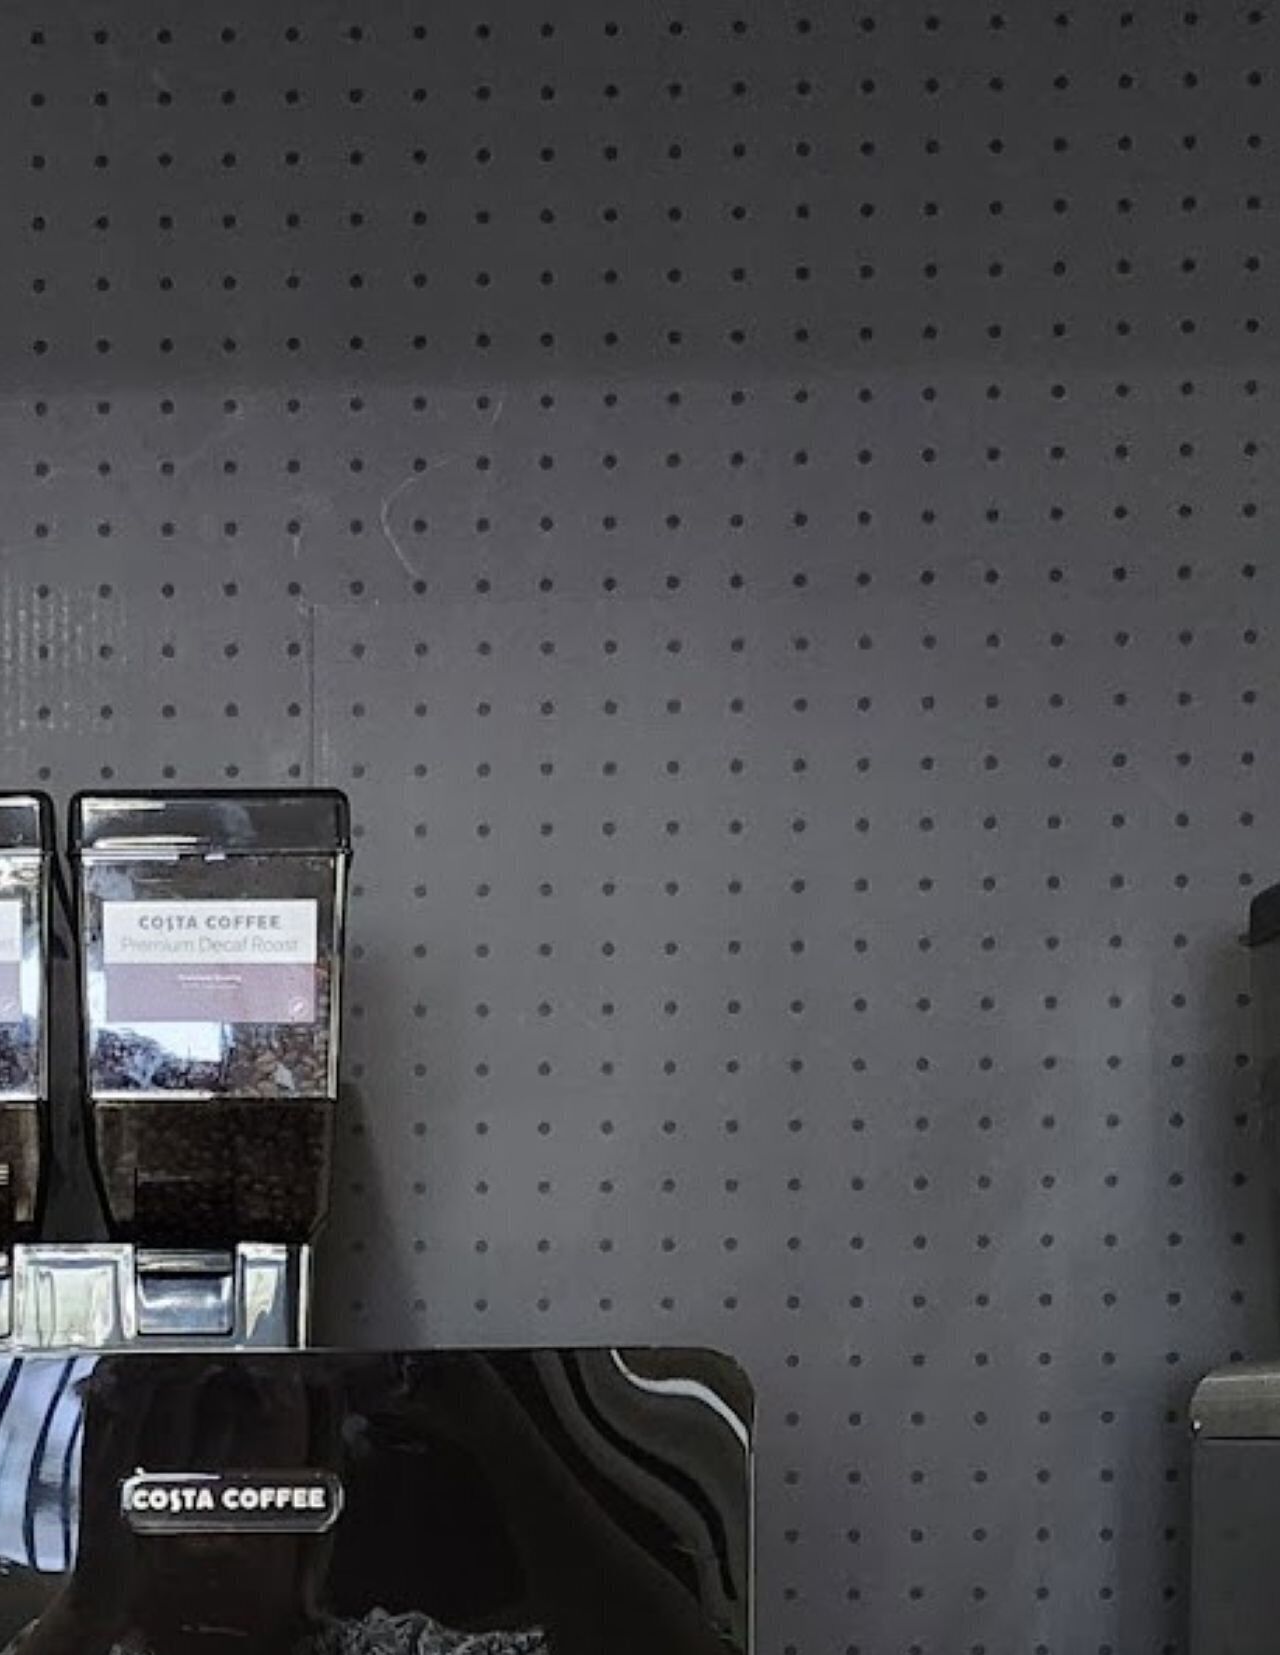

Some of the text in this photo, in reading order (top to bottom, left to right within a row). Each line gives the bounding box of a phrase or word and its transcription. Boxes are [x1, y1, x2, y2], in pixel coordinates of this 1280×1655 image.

[139, 915, 282, 933] COSTA COFFEE
[132, 1487, 326, 1513] COSTA COFFEE
